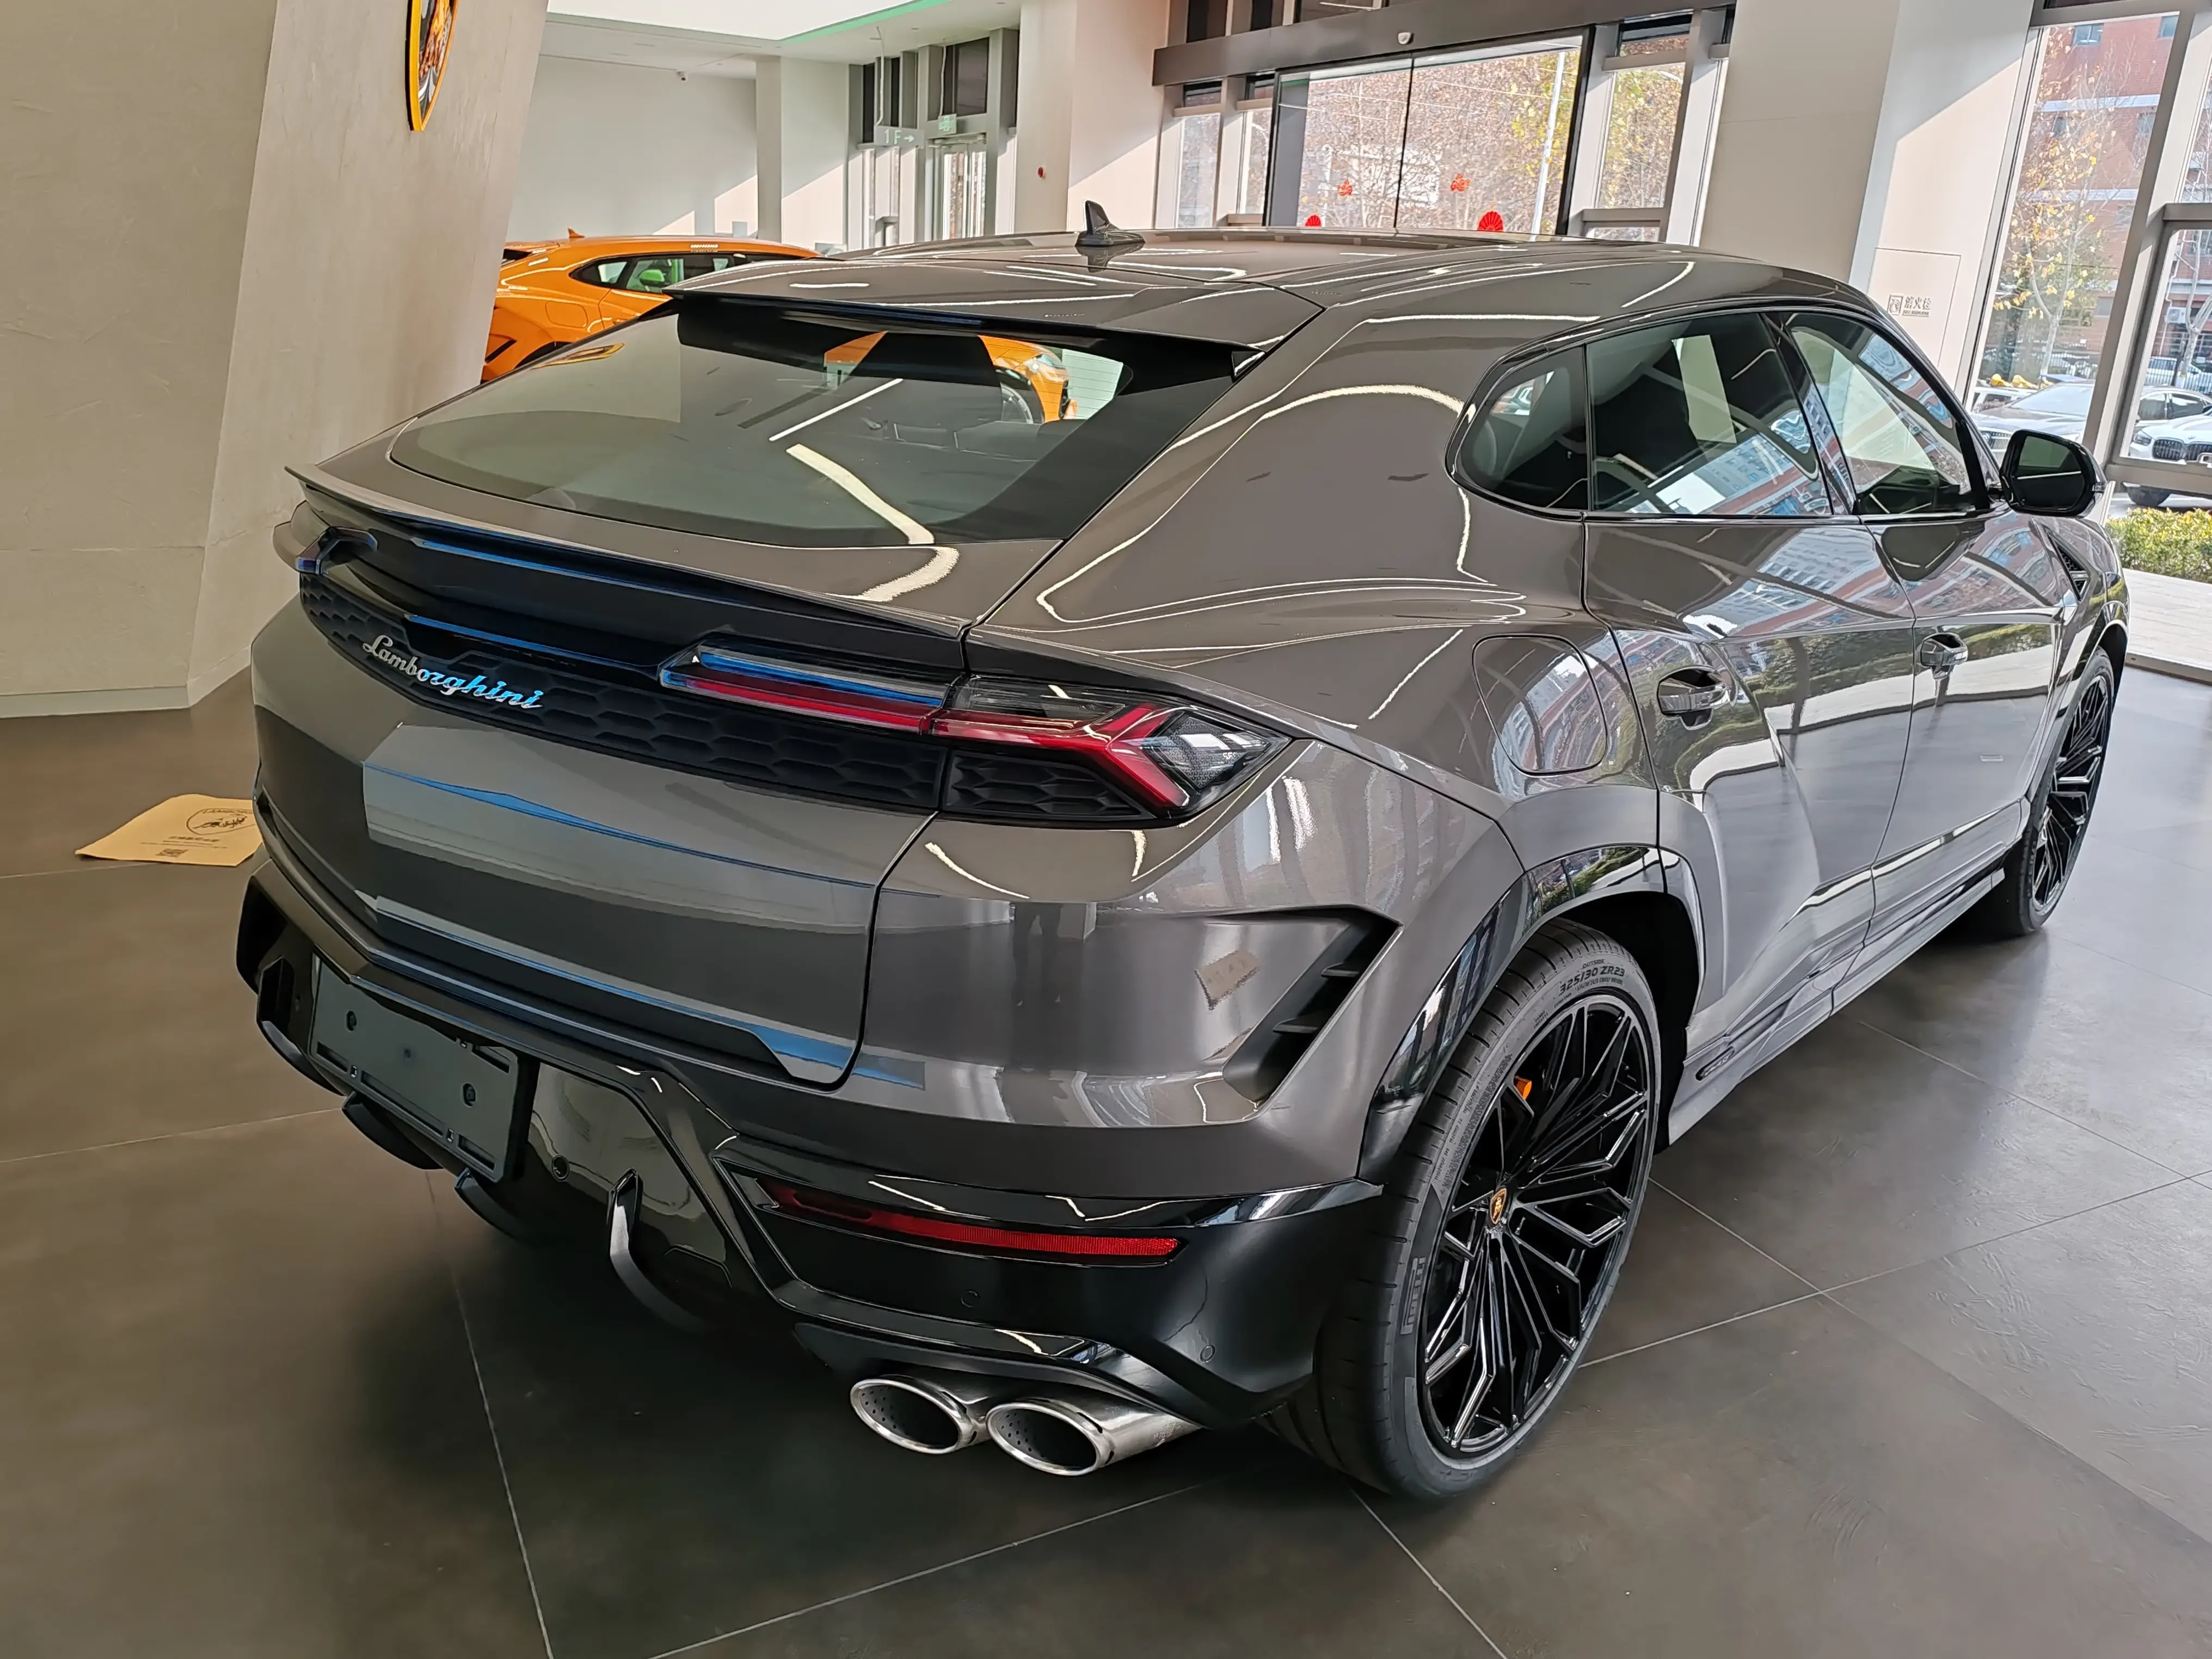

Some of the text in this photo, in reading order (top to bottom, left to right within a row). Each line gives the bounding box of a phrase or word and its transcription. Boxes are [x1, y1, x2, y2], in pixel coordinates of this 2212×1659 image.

[884, 129, 902, 145] 1F
[362, 635, 543, 708] Lamborghini
[1582, 959, 1605, 969] OUTSIDE
[1559, 967, 1599, 996] 325/30
[1600, 966, 1626, 977] ZR23
